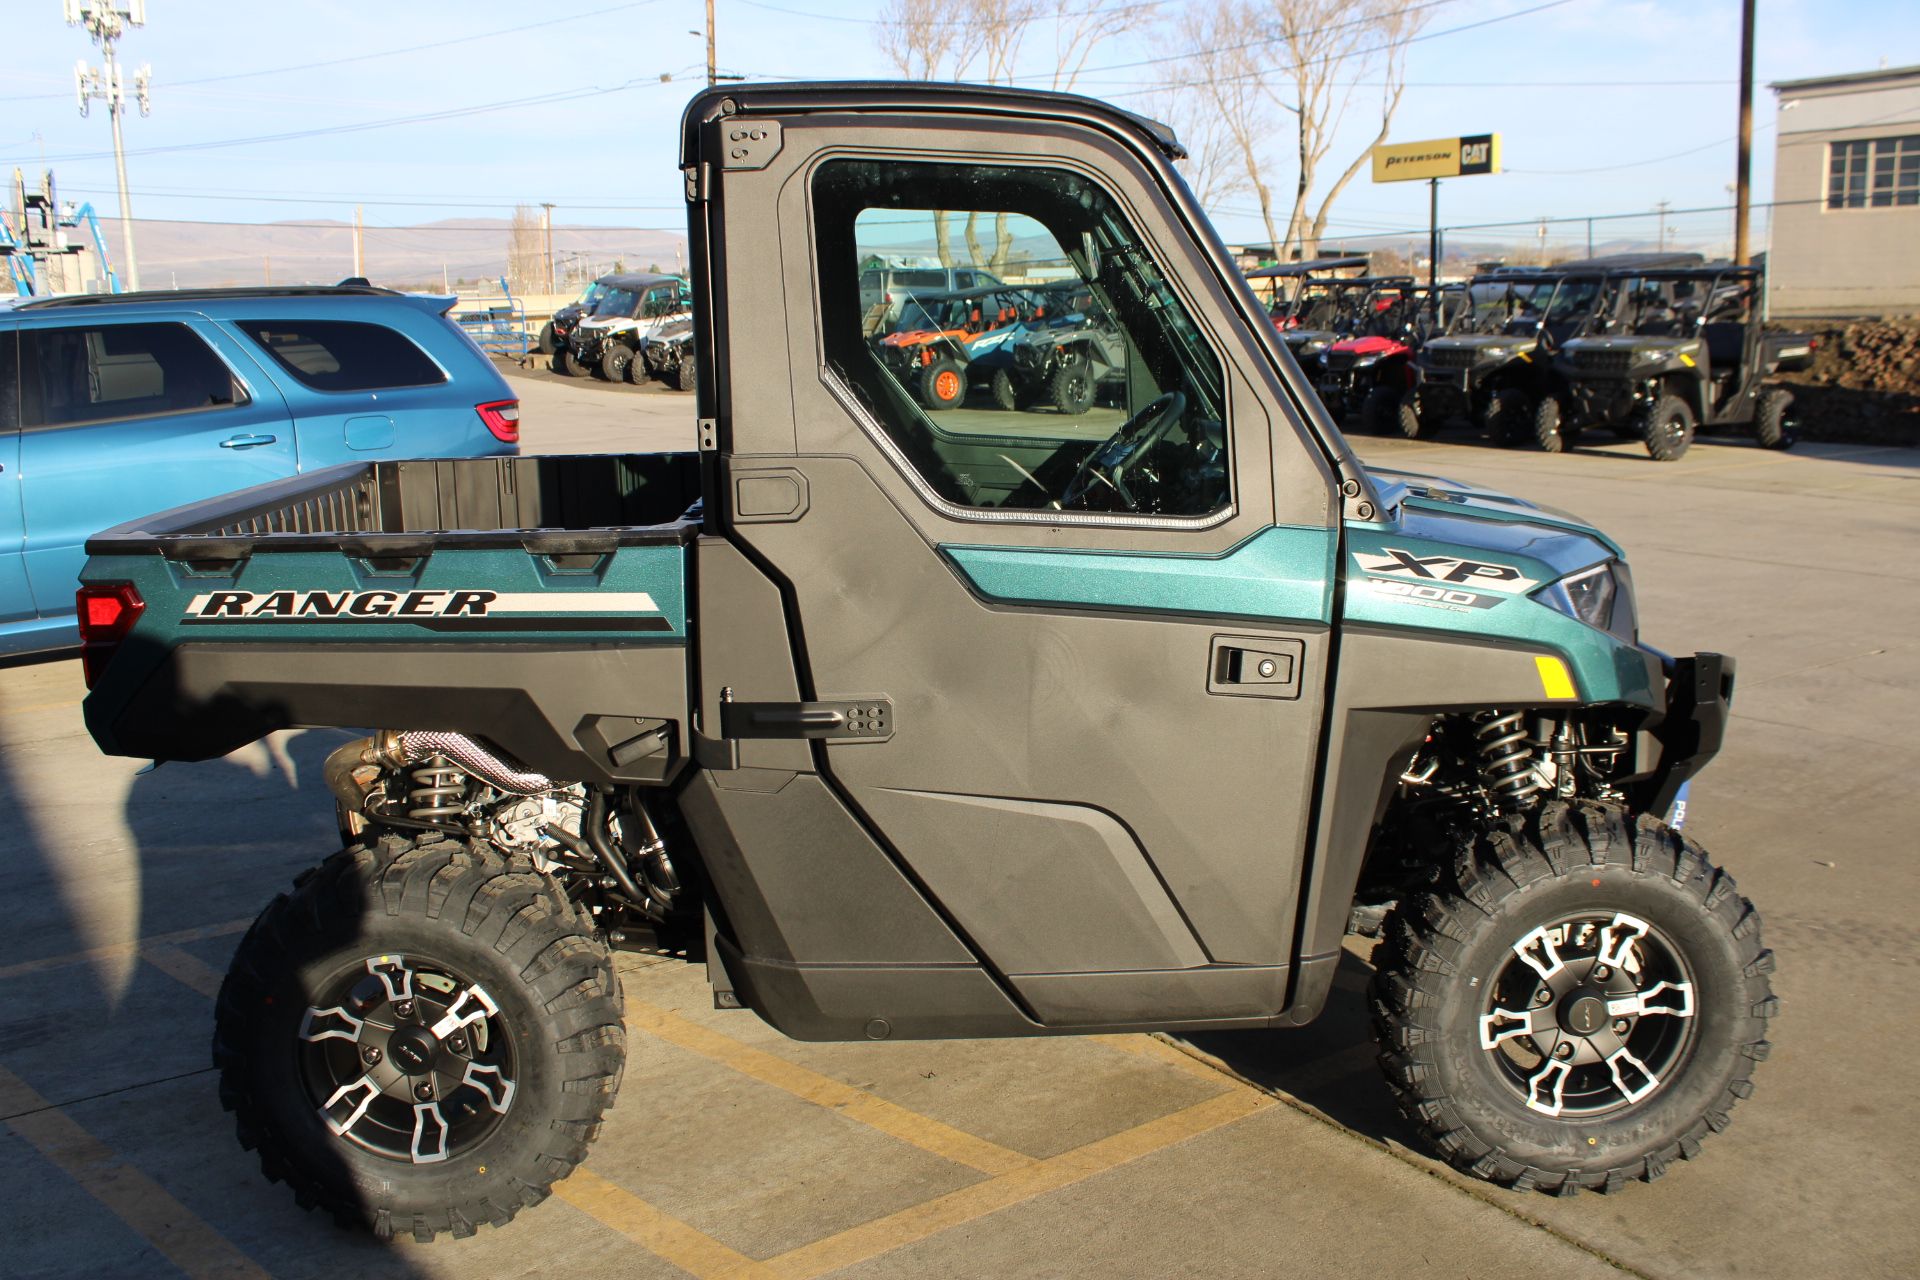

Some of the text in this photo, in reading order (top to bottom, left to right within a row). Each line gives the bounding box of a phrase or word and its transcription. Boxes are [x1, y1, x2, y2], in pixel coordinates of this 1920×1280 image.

[1385, 142, 1490, 169] PETERSON CAT
[1360, 547, 1524, 584] XP
[198, 588, 499, 617] RANGER
